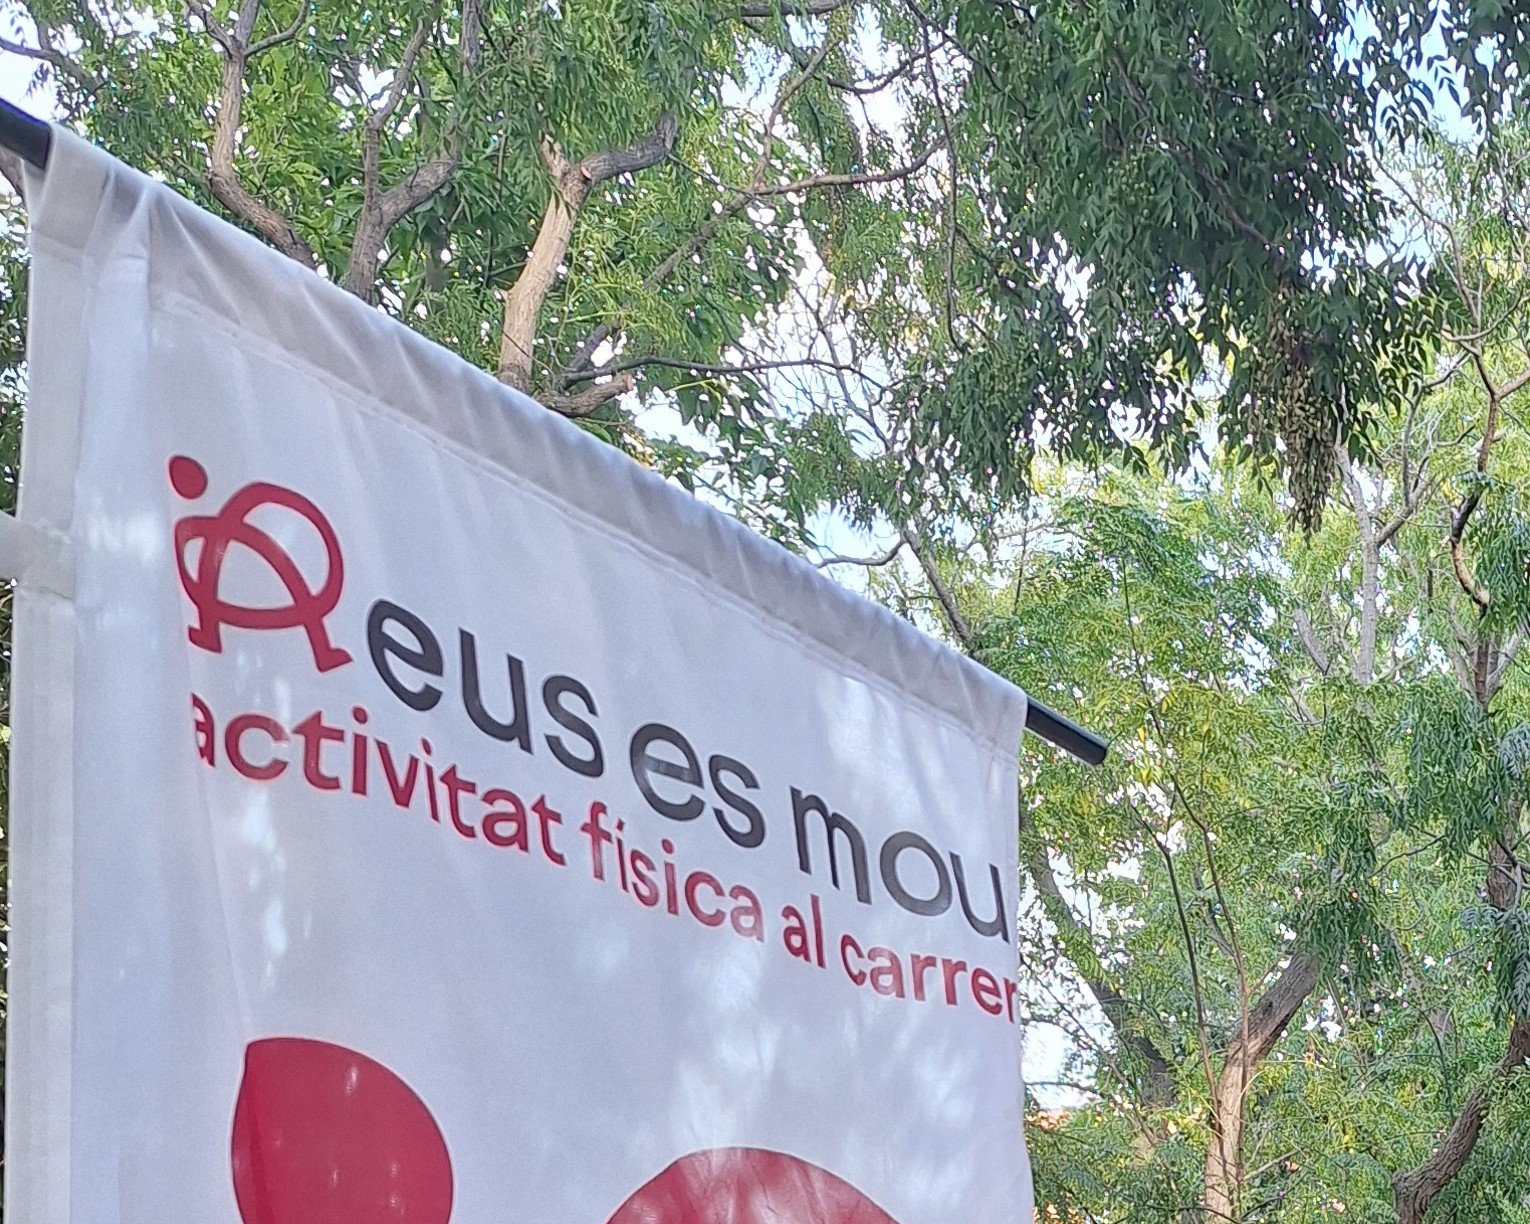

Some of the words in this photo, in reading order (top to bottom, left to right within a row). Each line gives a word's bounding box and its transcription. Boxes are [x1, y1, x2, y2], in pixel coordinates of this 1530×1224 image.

[629, 722, 766, 849] es
[790, 785, 1009, 944] mou
[781, 894, 826, 969] al
[840, 934, 1017, 1024] carrer
